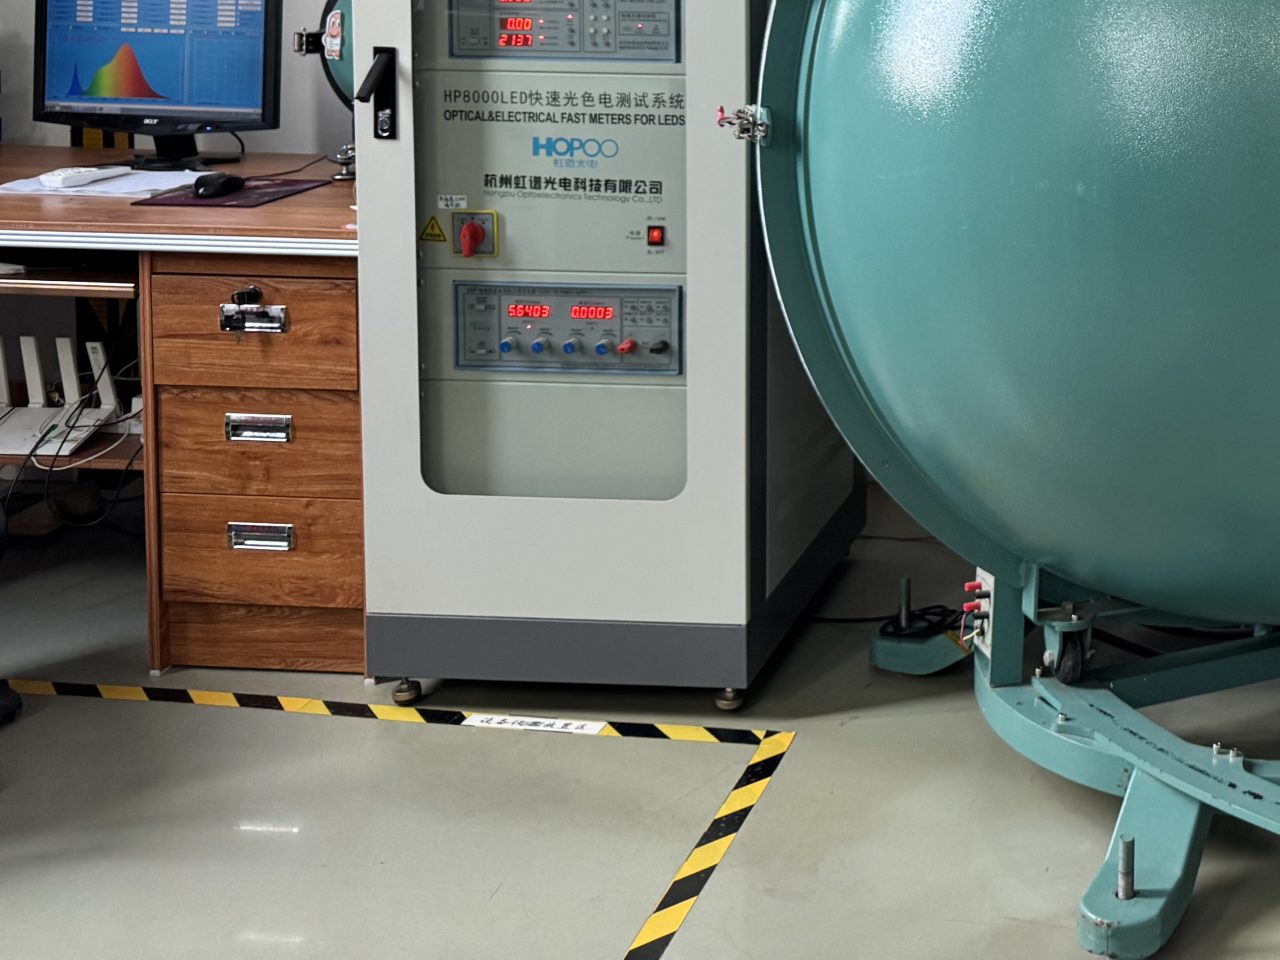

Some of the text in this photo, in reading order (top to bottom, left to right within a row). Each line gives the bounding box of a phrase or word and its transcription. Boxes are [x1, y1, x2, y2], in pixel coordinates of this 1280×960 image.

[443, 109, 686, 126] OPTICAL&ELECTRICAL FAST METERS FOR LEDS
[532, 136, 619, 158] HOPOO
[484, 173, 663, 195] 杭州虹谱光电科技有限公司
